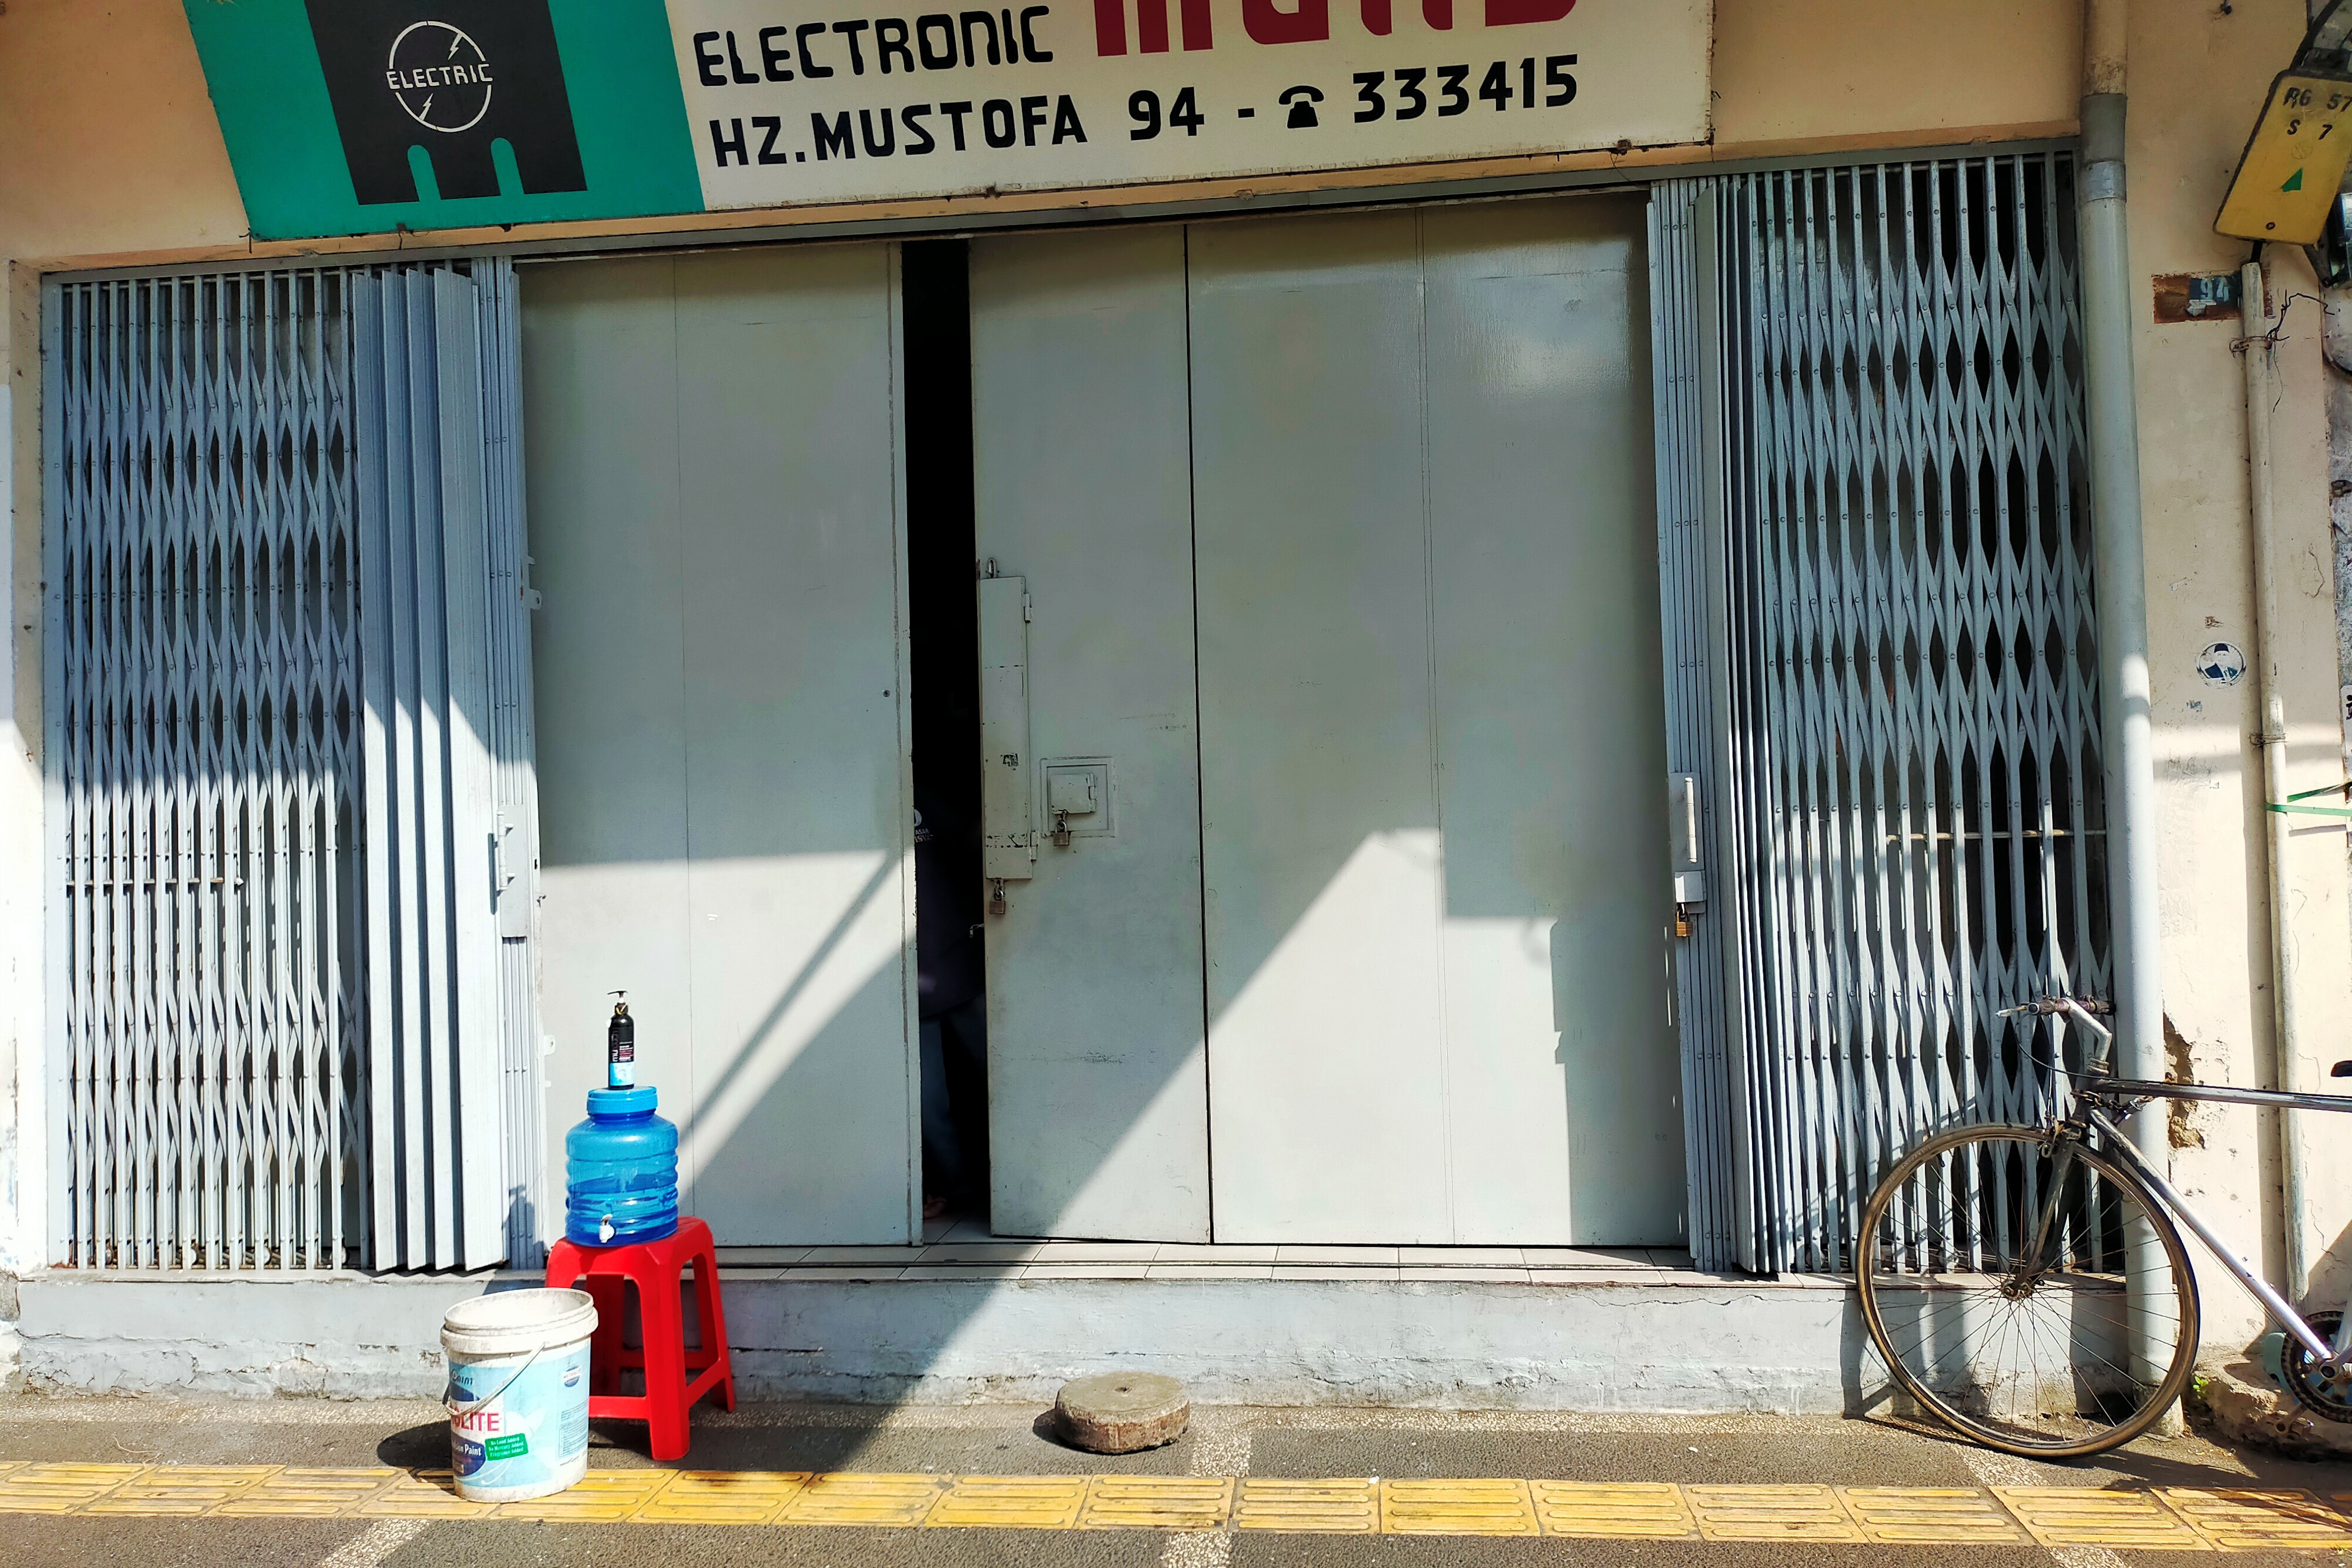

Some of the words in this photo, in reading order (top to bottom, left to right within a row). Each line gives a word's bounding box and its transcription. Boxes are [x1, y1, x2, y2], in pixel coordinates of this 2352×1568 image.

[694, 6, 1053, 86] ELECTRONIC
[387, 64, 493, 89] ELECTRIC
[709, 95, 1088, 168] HZ.MUSTOFA
[1128, 86, 1205, 141] 94
[1352, 54, 1578, 124] 333415
[2283, 86, 2312, 108] RG
[2327, 94, 2352, 112] 57
[2287, 119, 2300, 135] S
[2318, 124, 2333, 140] 7
[451, 1405, 499, 1432] OLITE
[465, 1443, 482, 1456] Paint
